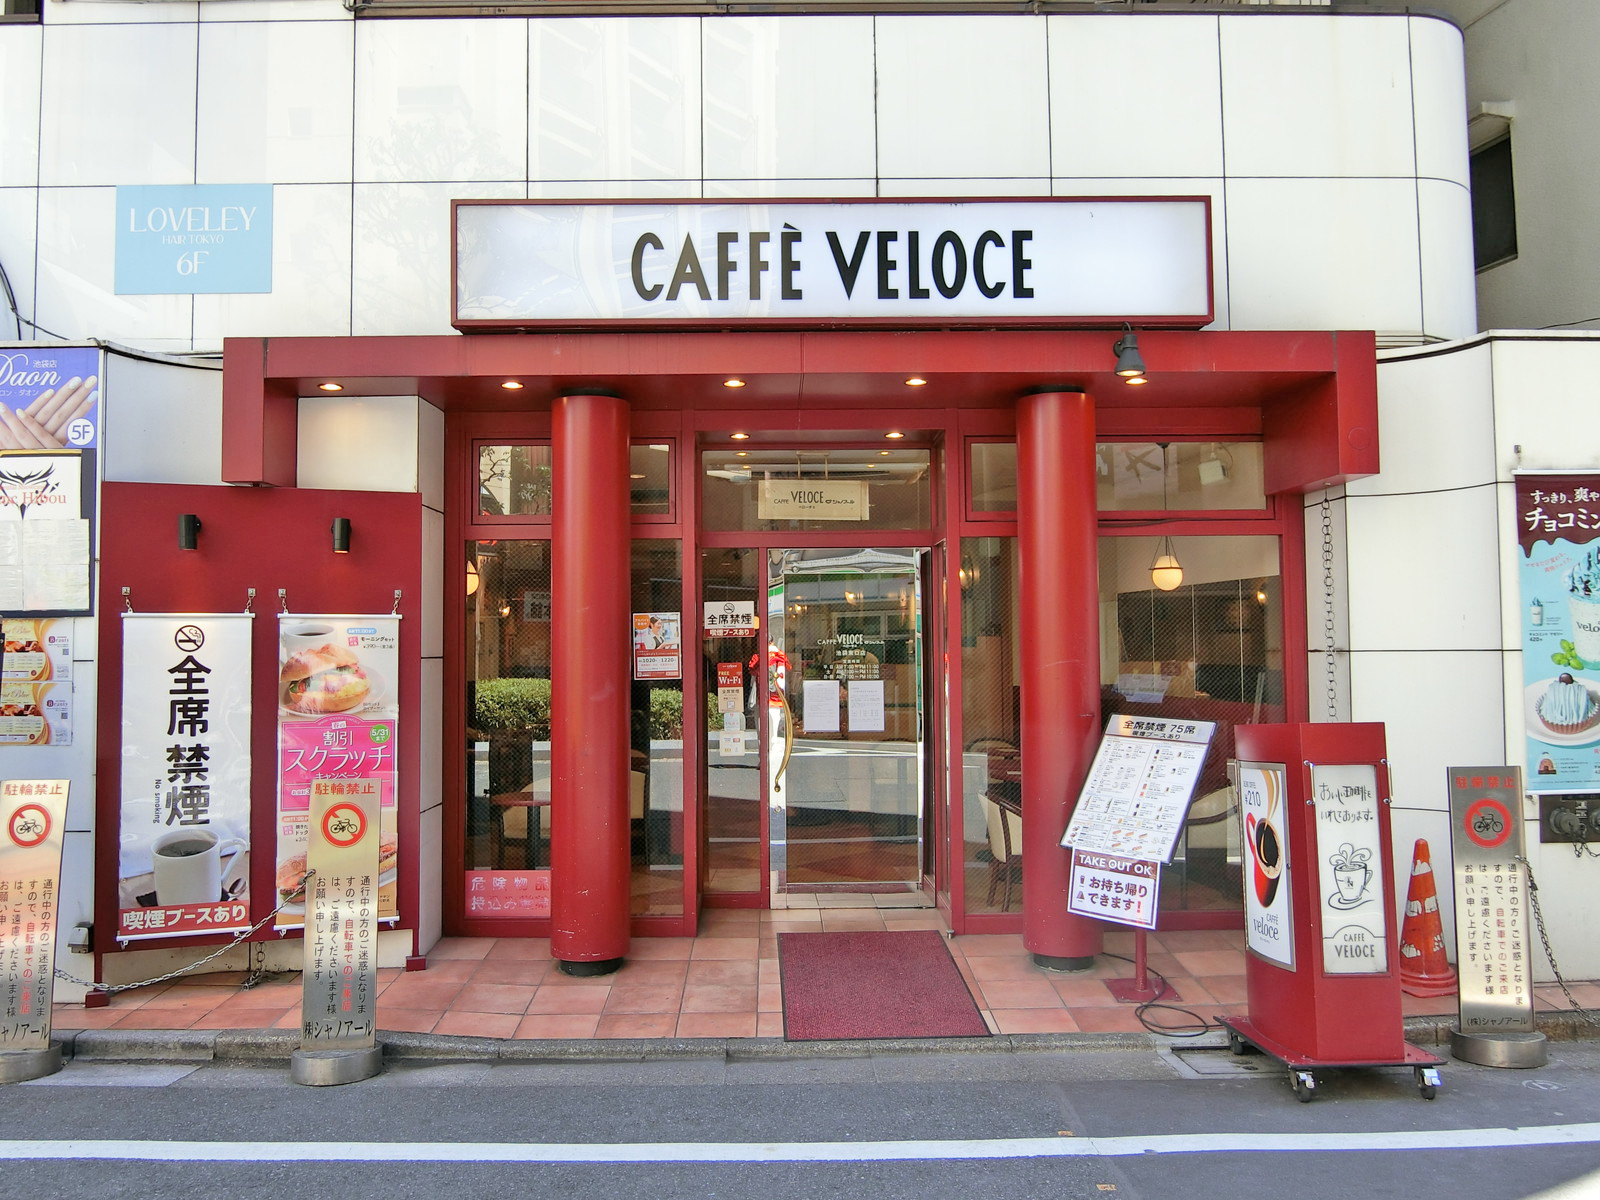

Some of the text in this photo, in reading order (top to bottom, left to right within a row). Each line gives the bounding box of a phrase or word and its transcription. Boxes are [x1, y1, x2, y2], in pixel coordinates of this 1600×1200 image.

[130, 206, 257, 232] LOVELEY
[163, 234, 224, 244] HAIR TOKYO
[176, 251, 209, 275] 6F
[631, 222, 1034, 301] CAFFÈ VELOCE
[33, 359, 57, 368] 池袋店
[71, 424, 91, 440] 5F
[790, 490, 824, 504] VELOCE
[707, 613, 752, 625] 全席禁煙
[837, 633, 864, 645] VELOCE
[1123, 720, 1196, 734] 全席禁煙 75席
[165, 655, 212, 826] 全席禁煙
[323, 730, 353, 746] 割引
[285, 745, 391, 772] スクラッチ
[4, 784, 63, 796] 駐輪禁止
[315, 783, 375, 795] 駐輪禁止
[153, 778, 162, 824] No smoking
[1245, 790, 1261, 807] ¥210
[1079, 854, 1152, 876] TAKE OUT OK
[1089, 877, 1148, 898] お持ち帰り
[123, 905, 246, 930] 喫煙ブースあり
[1253, 917, 1279, 940] veloce
[1334, 944, 1375, 958] VELOCE
